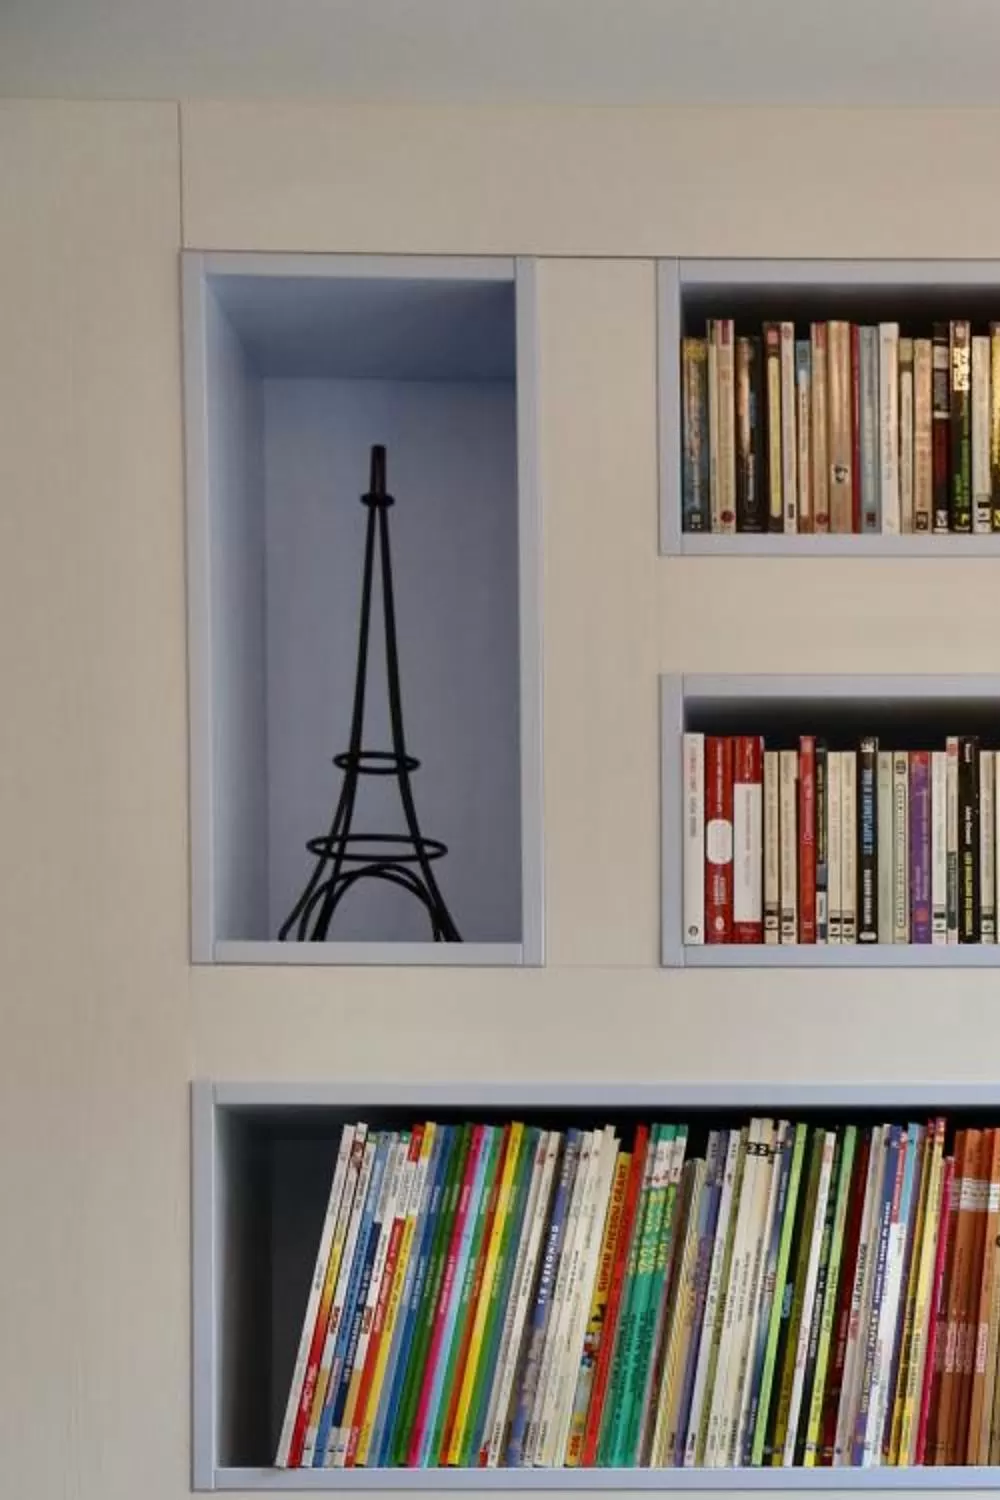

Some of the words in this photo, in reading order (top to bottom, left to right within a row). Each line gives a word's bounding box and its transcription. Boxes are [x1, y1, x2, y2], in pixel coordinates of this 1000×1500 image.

[612, 1163, 628, 1204] GÉANT
[604, 1204, 621, 1250] PICSOU
[597, 1250, 613, 1293] SUPER
